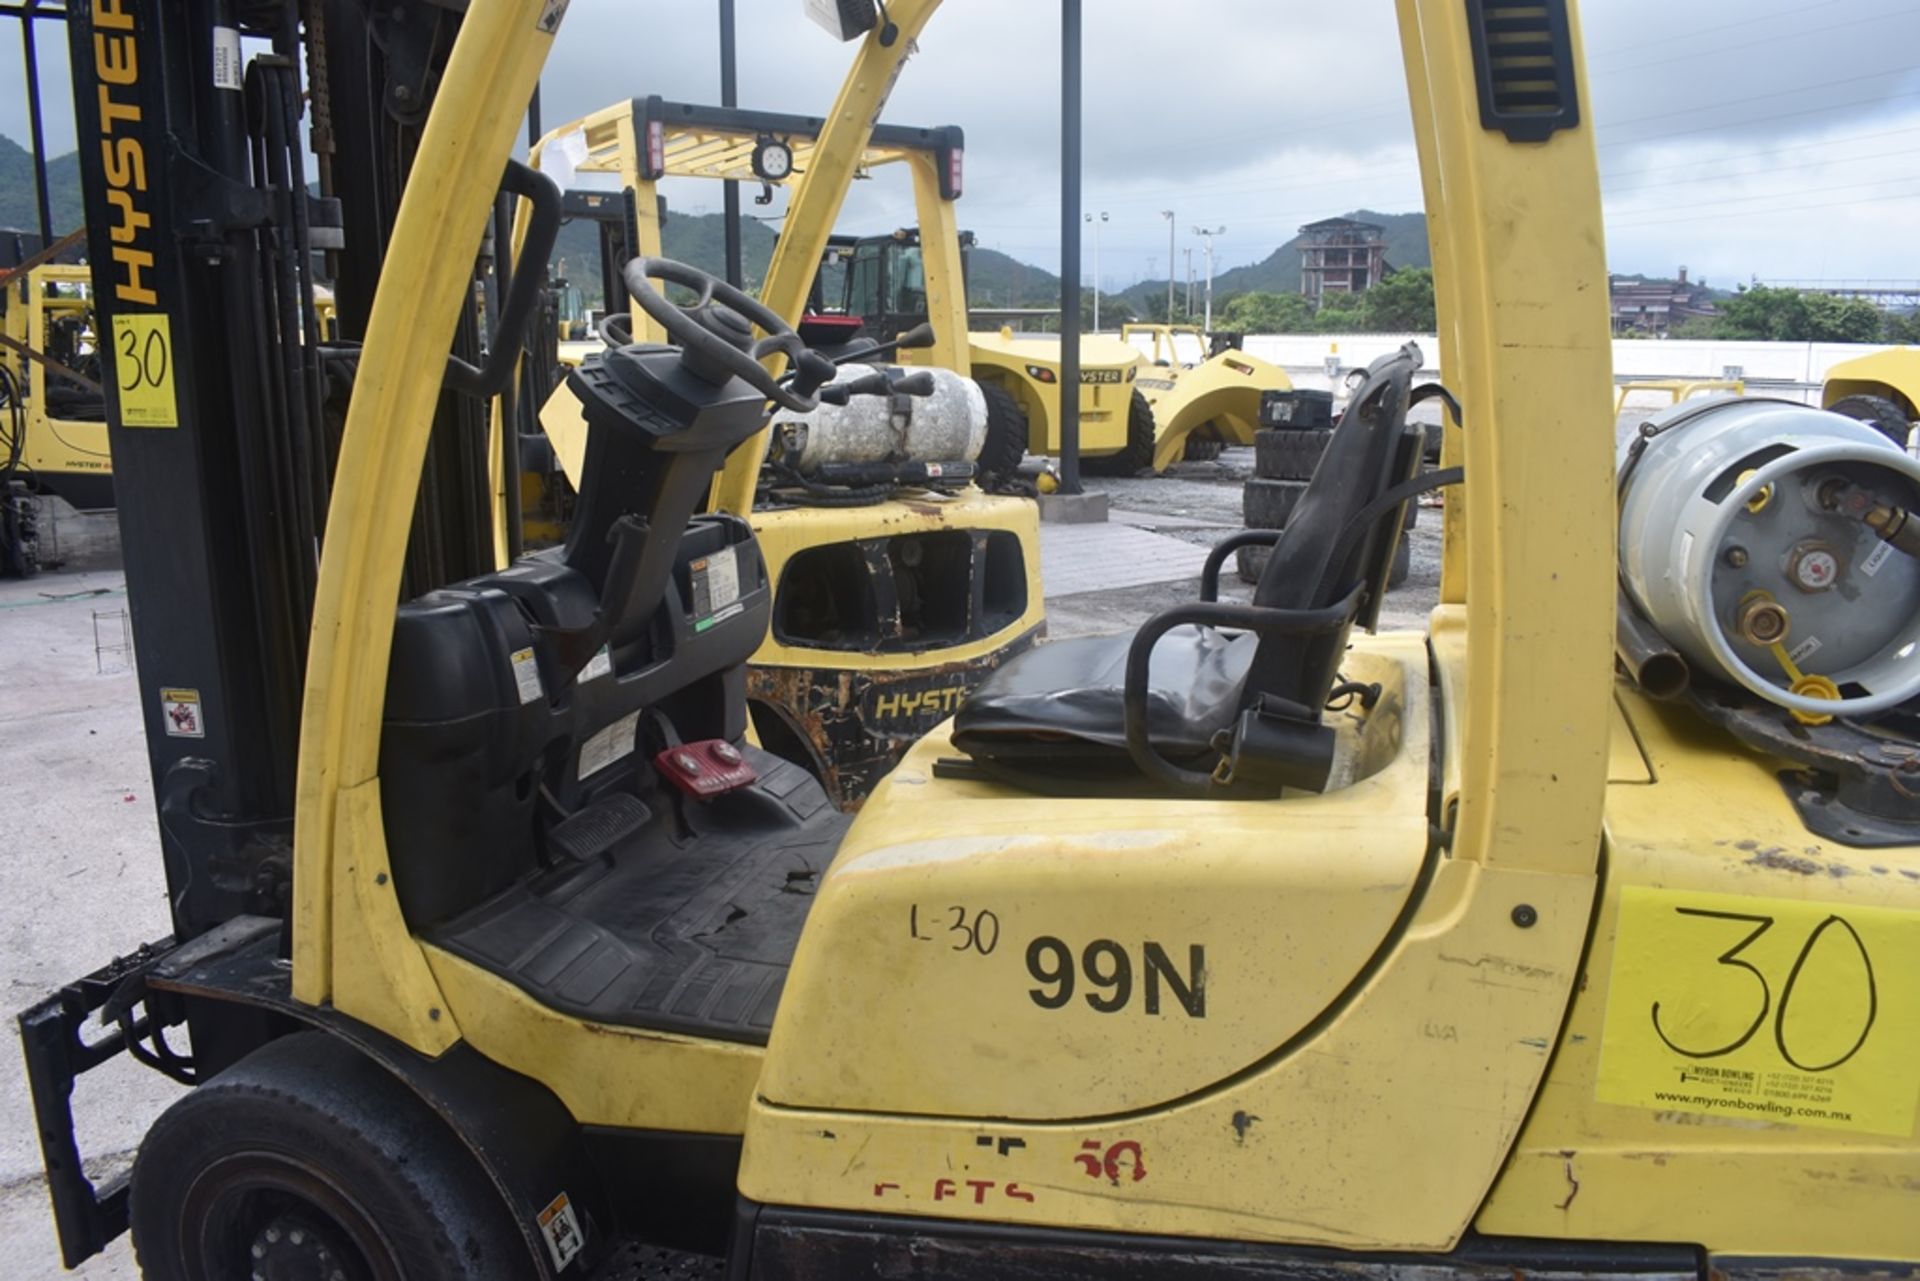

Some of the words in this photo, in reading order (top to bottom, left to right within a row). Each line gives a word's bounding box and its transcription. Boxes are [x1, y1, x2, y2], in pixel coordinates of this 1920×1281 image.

[120, 328, 167, 391] 30
[911, 904, 999, 955] L-30
[1025, 936, 1206, 1019] 99N
[1652, 906, 1877, 1072] 30
[1721, 1068, 1755, 1081] BOWLING
[1655, 1092, 1852, 1121] www.myronbowling.com.mx
